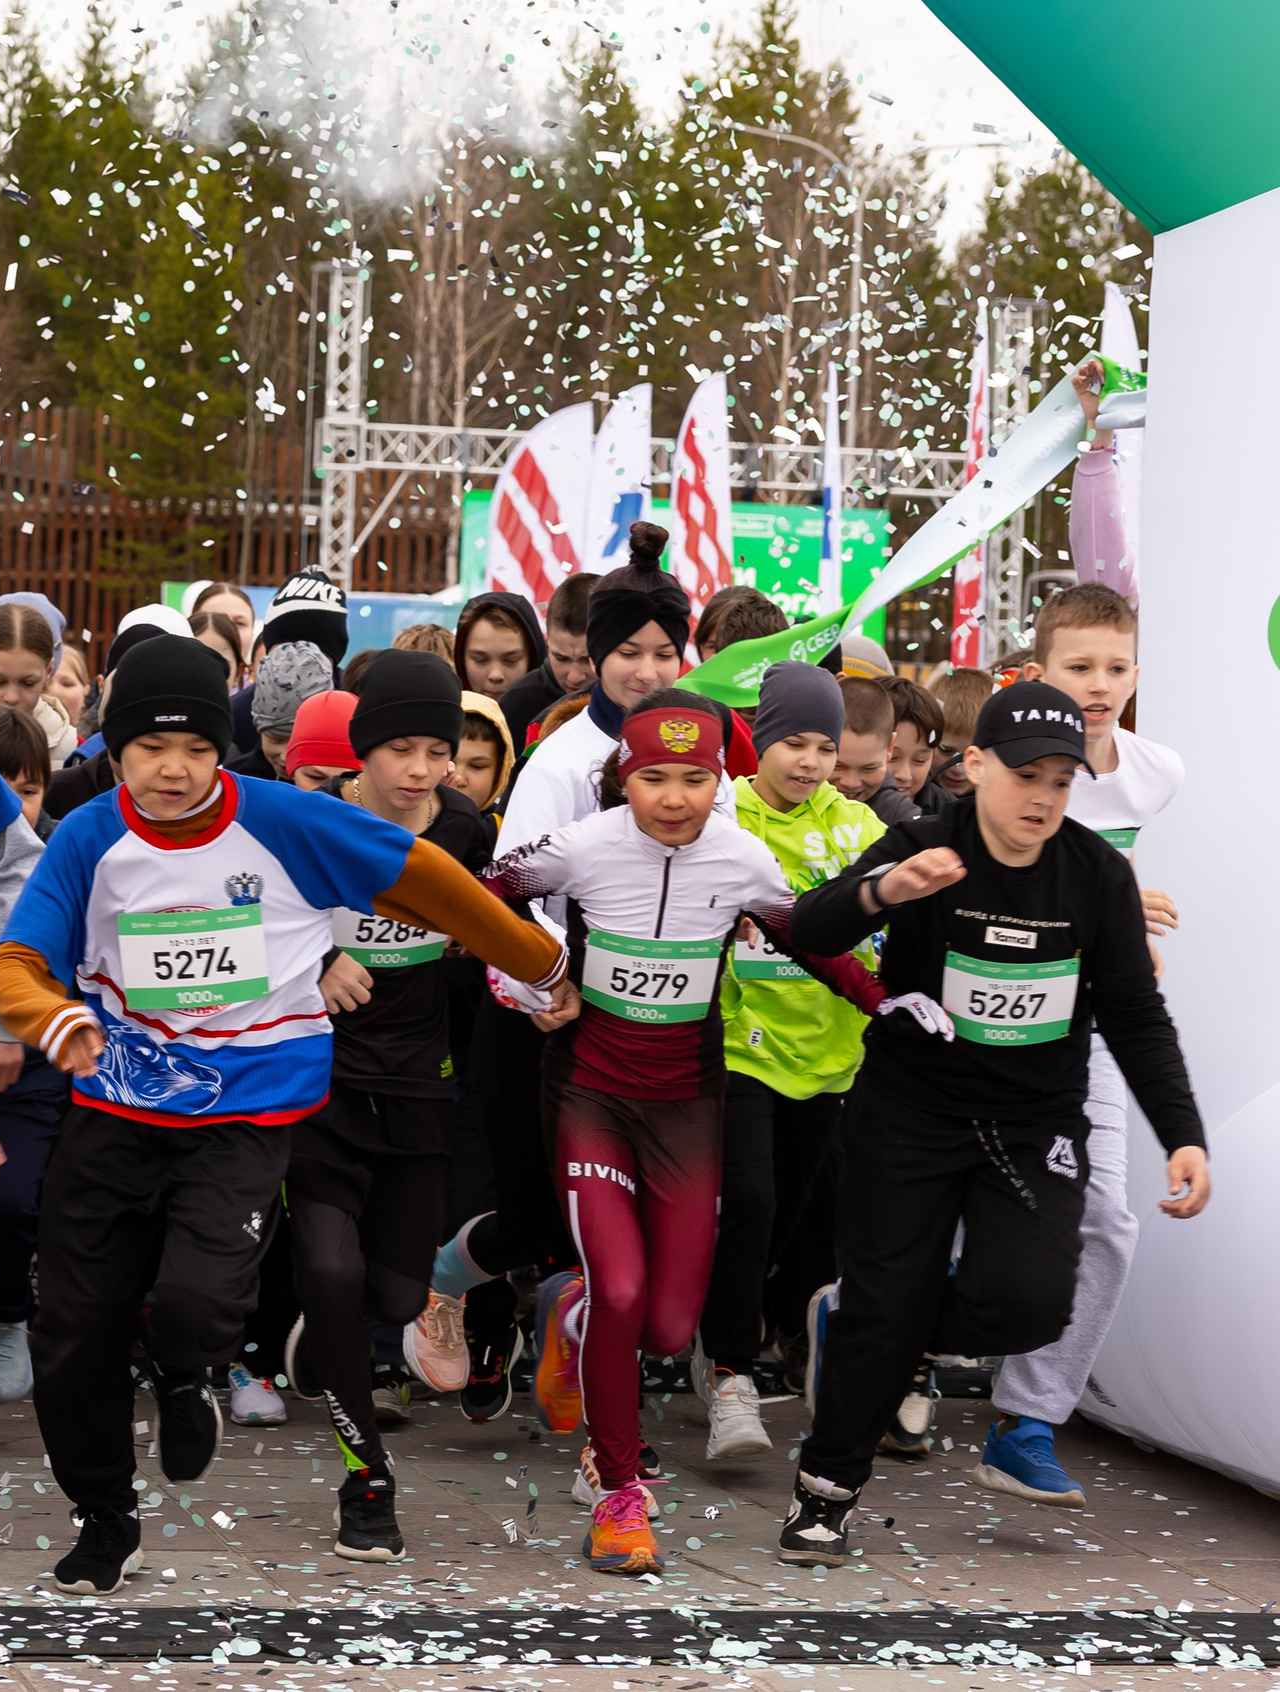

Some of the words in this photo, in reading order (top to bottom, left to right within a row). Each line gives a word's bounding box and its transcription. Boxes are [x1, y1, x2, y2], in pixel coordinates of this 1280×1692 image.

[276, 577, 342, 604] NIKE
[806, 623, 840, 652] СБЕР
[1011, 709, 1084, 732] YAMAL
[153, 946, 237, 980] 5274
[369, 953, 401, 964] 1000
[775, 965, 804, 976] 1000
[610, 966, 689, 999] 5279
[176, 991, 213, 1004] 1000
[968, 989, 1047, 1019] 5267
[625, 1005, 658, 1019] 1000
[983, 1028, 1018, 1040] 1000
